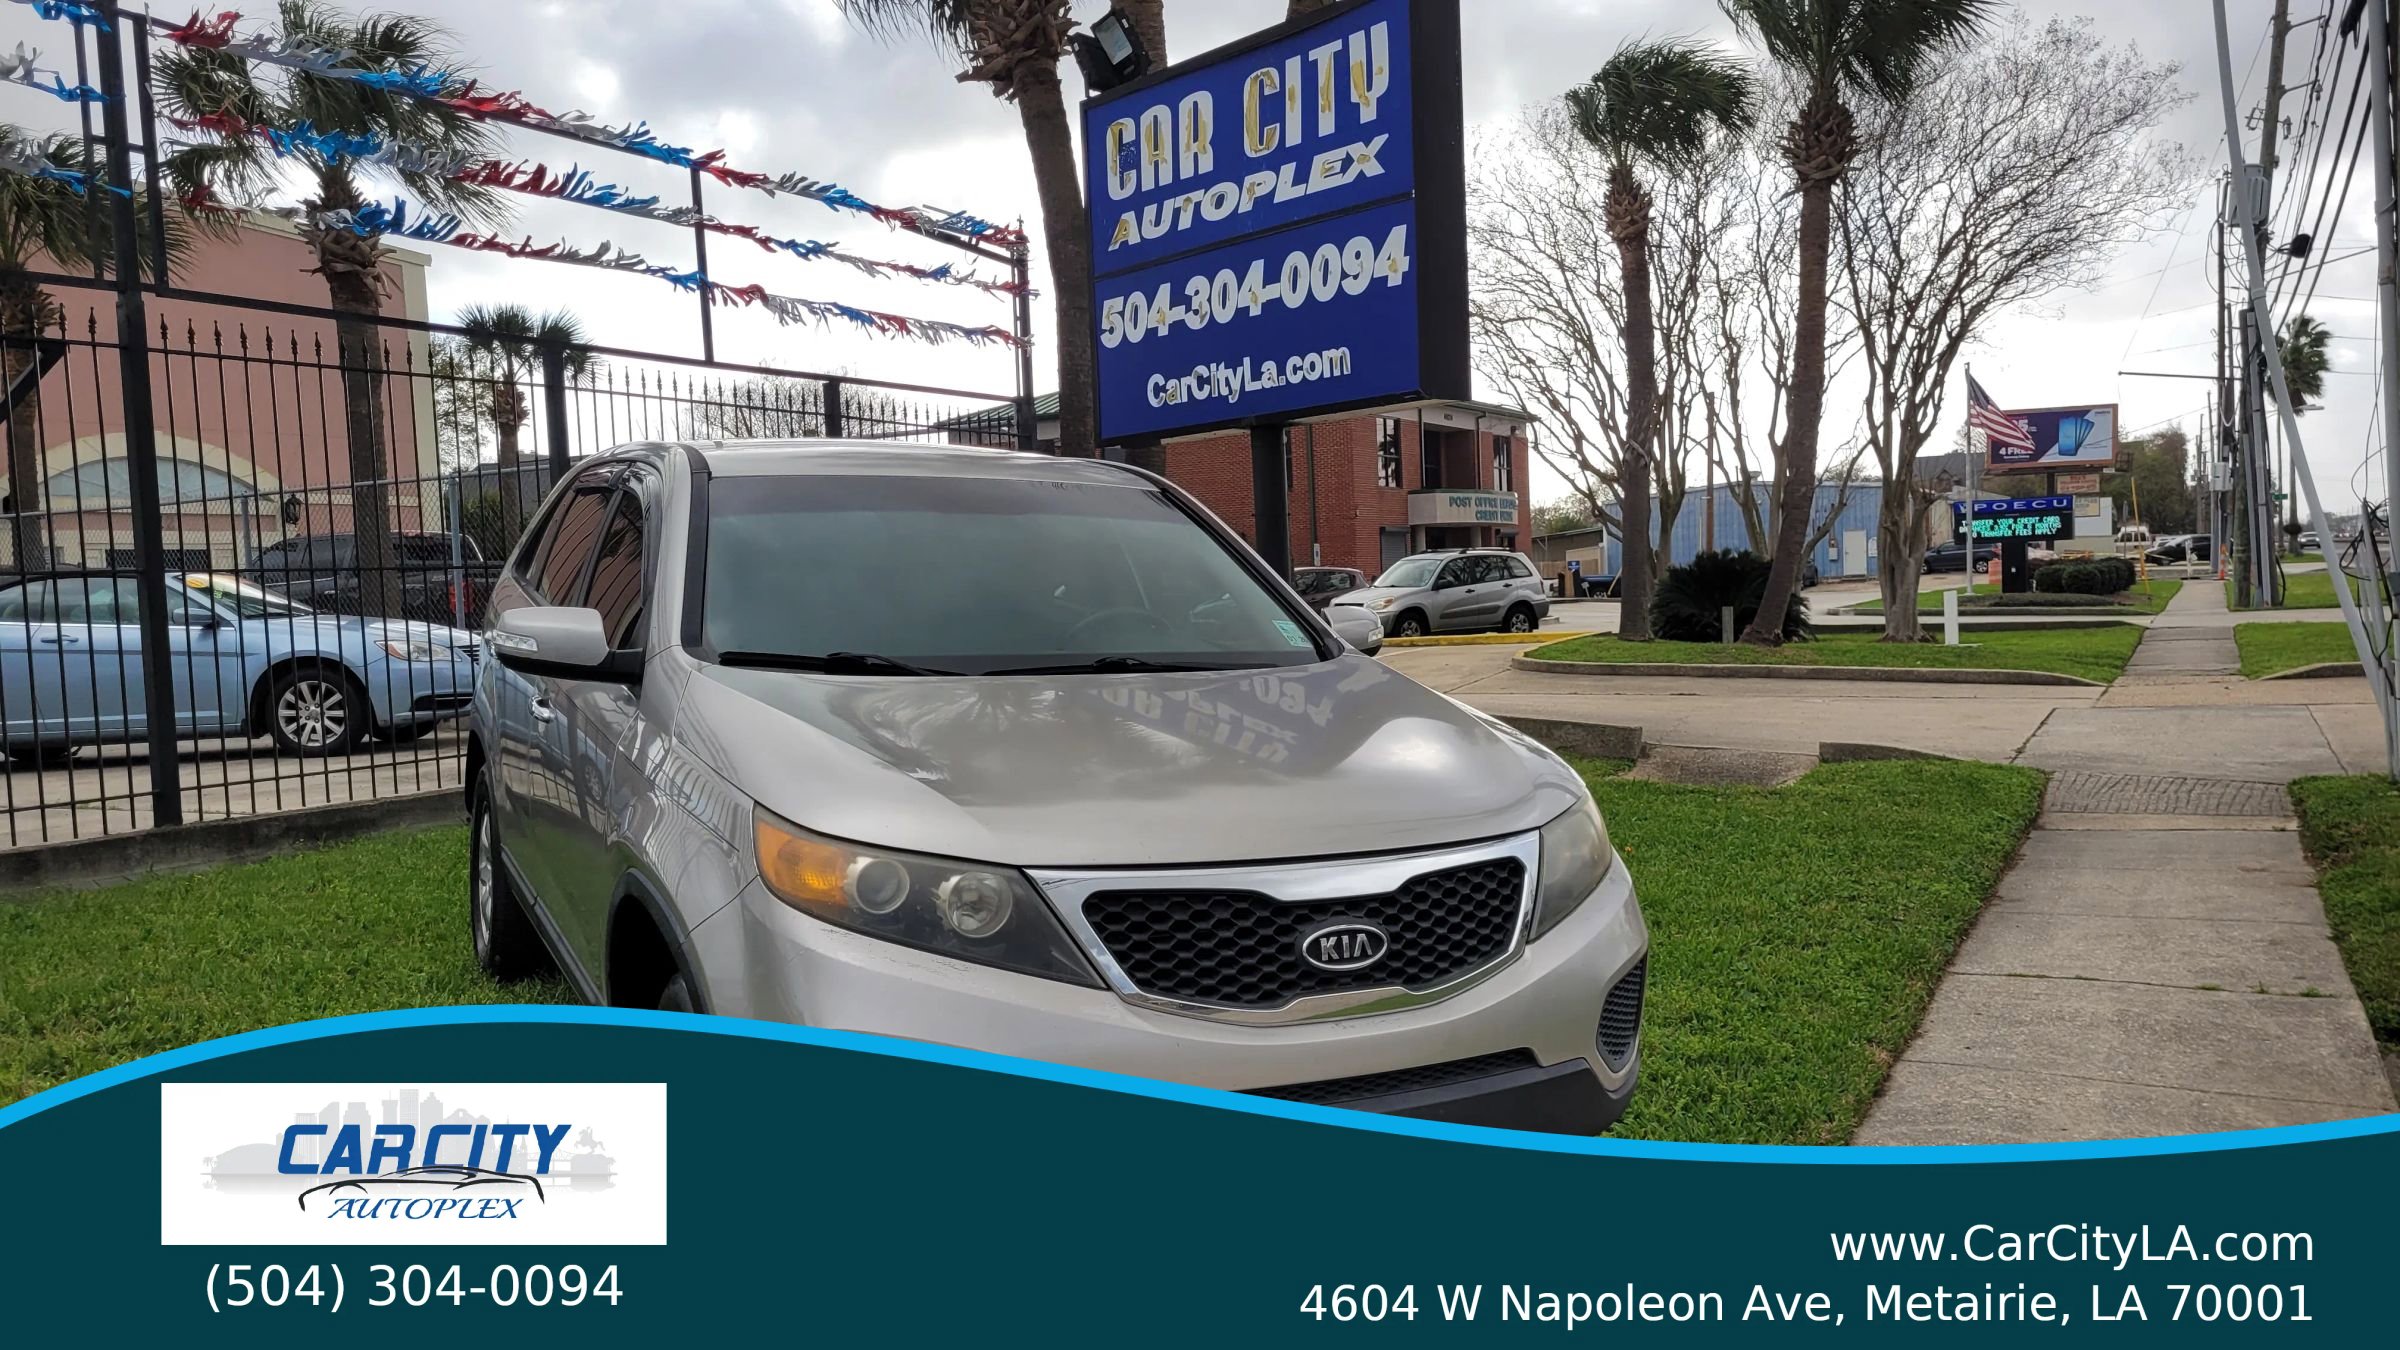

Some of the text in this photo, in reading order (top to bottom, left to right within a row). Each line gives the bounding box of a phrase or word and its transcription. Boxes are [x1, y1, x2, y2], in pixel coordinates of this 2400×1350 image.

[1106, 20, 1390, 201] CAR CITY
[1108, 133, 1389, 251] AUTOPLEX
[1100, 225, 1410, 349] 504-304-0094
[1147, 346, 1351, 408] CarCityLa.com
[1449, 495, 1473, 508] POST
[1319, 933, 1373, 961] KIA
